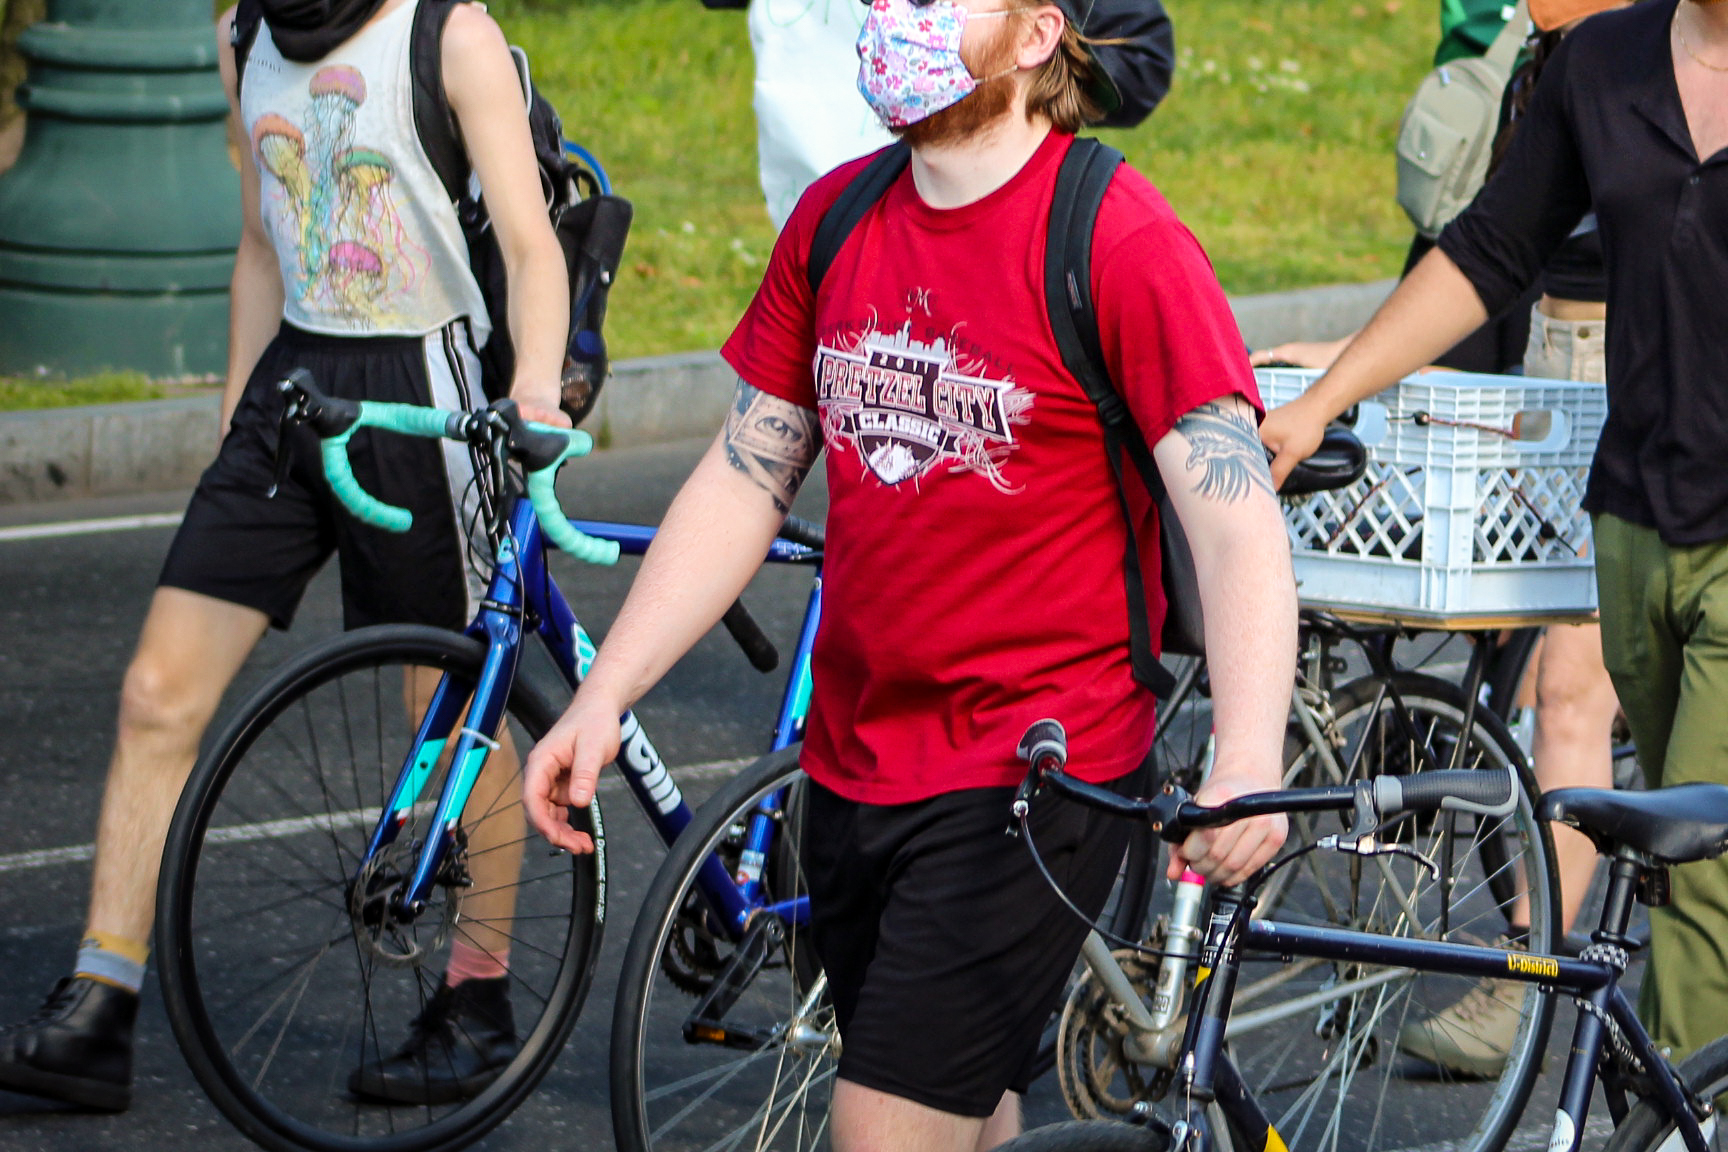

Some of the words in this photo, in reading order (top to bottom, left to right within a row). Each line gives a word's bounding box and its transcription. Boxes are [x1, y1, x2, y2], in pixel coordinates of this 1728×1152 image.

[878, 353, 930, 375] 2011
[819, 355, 927, 415] PRETZEL
[932, 378, 998, 432] CITY
[858, 411, 943, 447] CLASSIC
